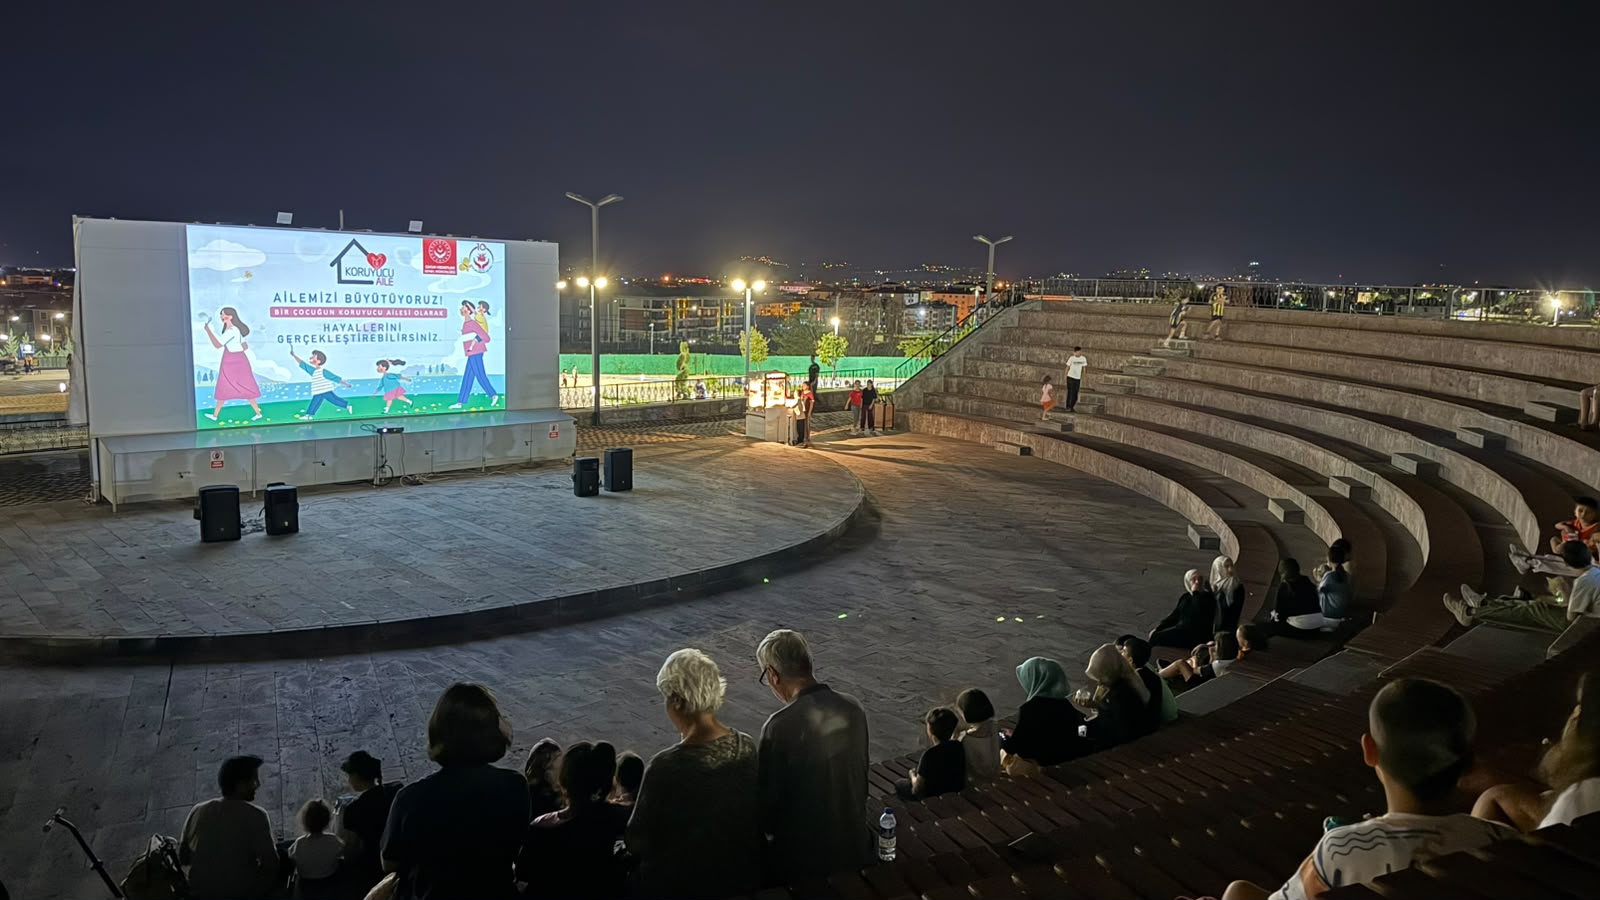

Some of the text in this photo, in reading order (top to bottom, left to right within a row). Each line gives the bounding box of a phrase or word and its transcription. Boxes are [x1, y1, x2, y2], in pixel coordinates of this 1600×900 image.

[345, 267, 395, 278] KORUYUCU
[273, 290, 443, 305] AİLEMİZİ BÜYÜTÜYORUZ!
[274, 308, 289, 316] BİR
[293, 308, 335, 317] ÇOCUĞUN
[338, 308, 383, 317] KORUYUCU
[386, 308, 411, 317] AİLESİ
[323, 322, 402, 332] HAYALLERİNİ
[277, 333, 442, 345] GERÇEKLEŞTİREBİLİRSİNİZ.
